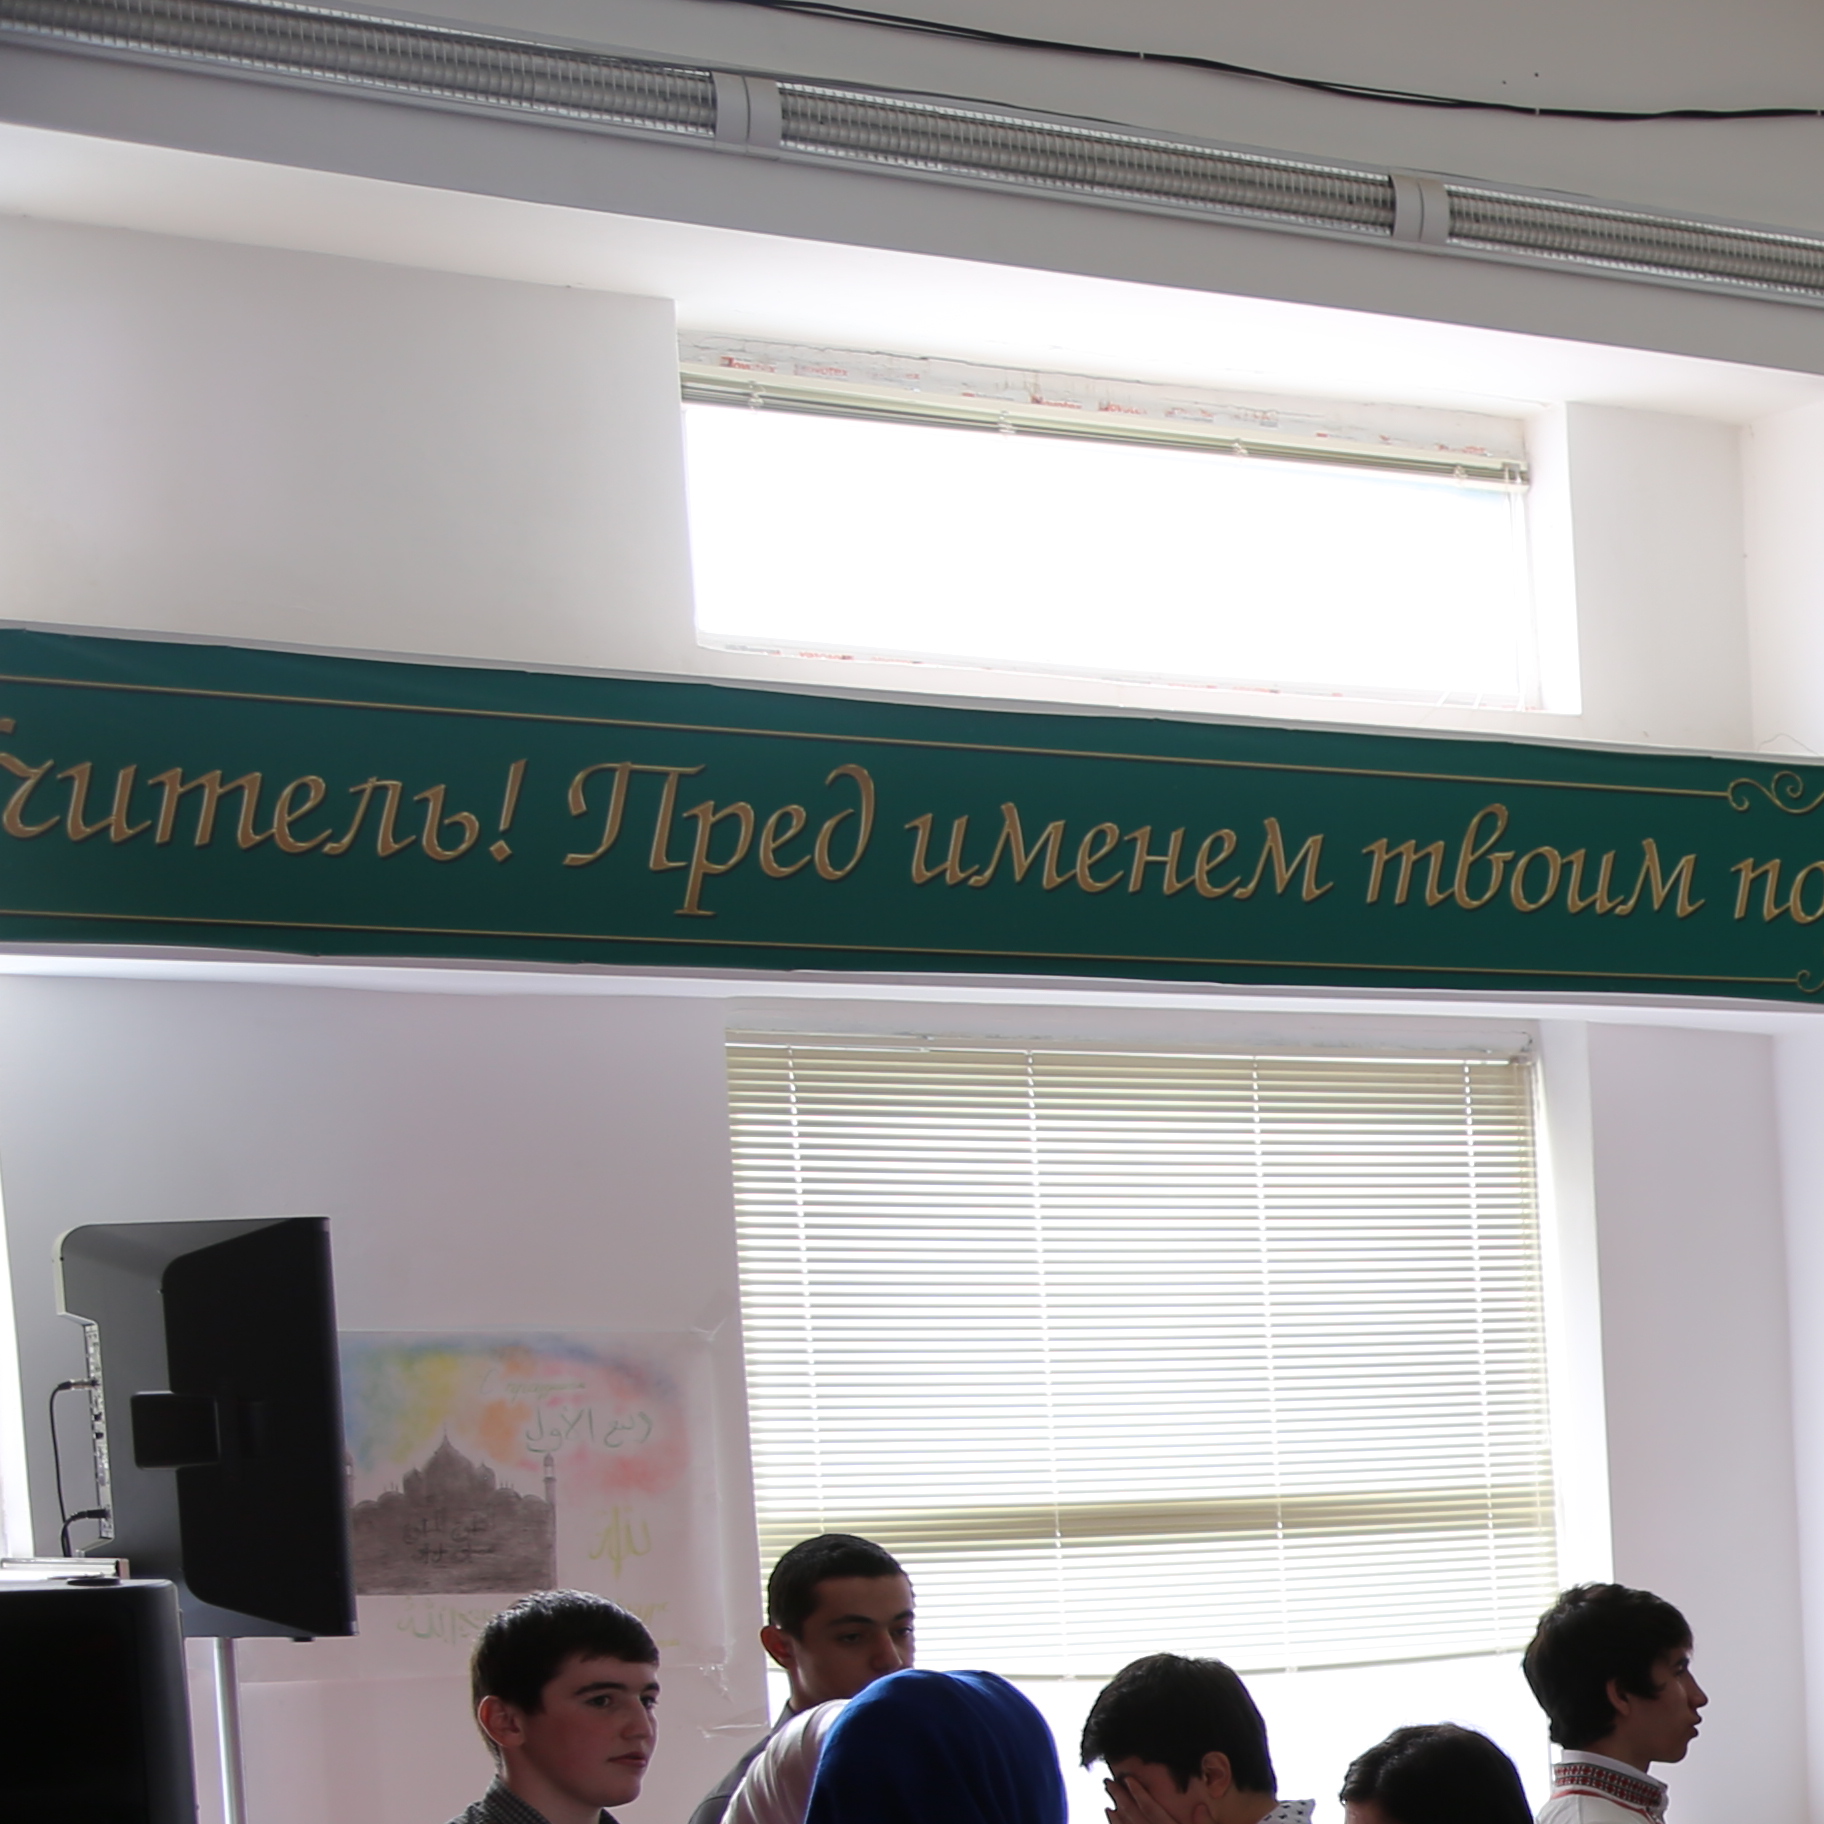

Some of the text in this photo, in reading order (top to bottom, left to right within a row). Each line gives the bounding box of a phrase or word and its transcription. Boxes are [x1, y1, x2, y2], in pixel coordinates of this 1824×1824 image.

[0, 718, 528, 862] читель!
[562, 760, 876, 917] Пред
[903, 801, 1336, 903] именем
[1361, 802, 1705, 919] твоим
